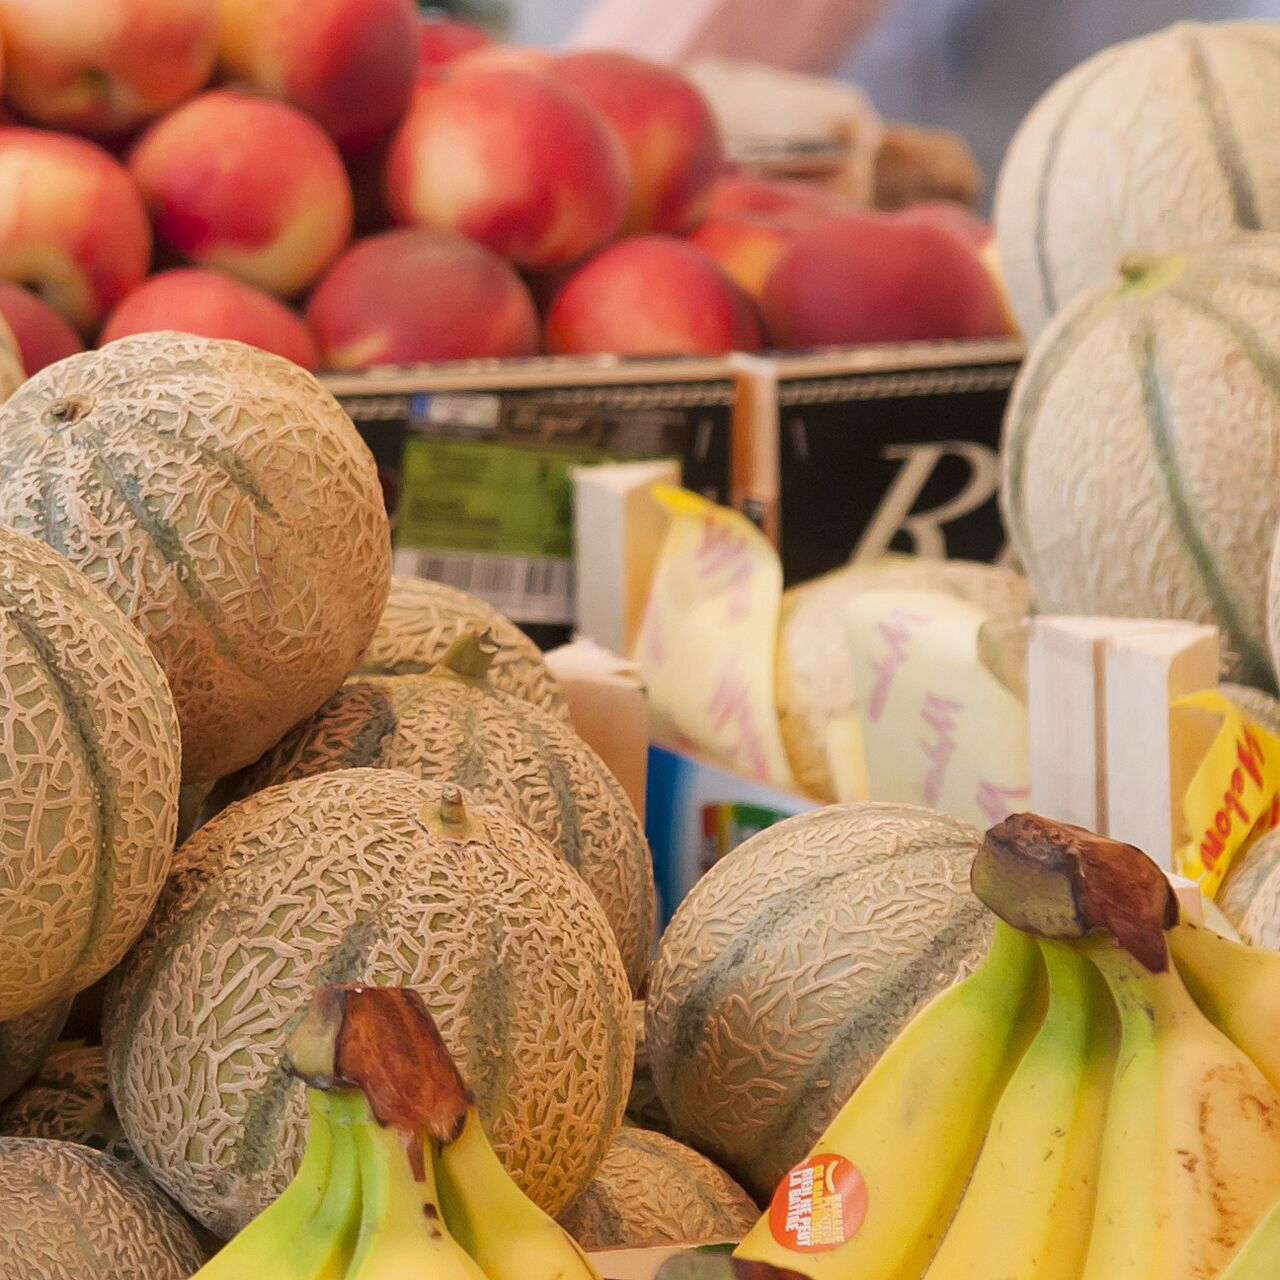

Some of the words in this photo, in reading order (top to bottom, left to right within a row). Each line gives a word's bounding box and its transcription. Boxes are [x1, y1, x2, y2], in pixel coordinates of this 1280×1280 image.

[848, 440, 1014, 566] R
[789, 1169, 802, 1188] LA
[801, 1167, 814, 1196] RIEN
[786, 1189, 801, 1232] BATTRE
[800, 1197, 813, 1215] NE
[797, 1216, 812, 1247] PEUT
